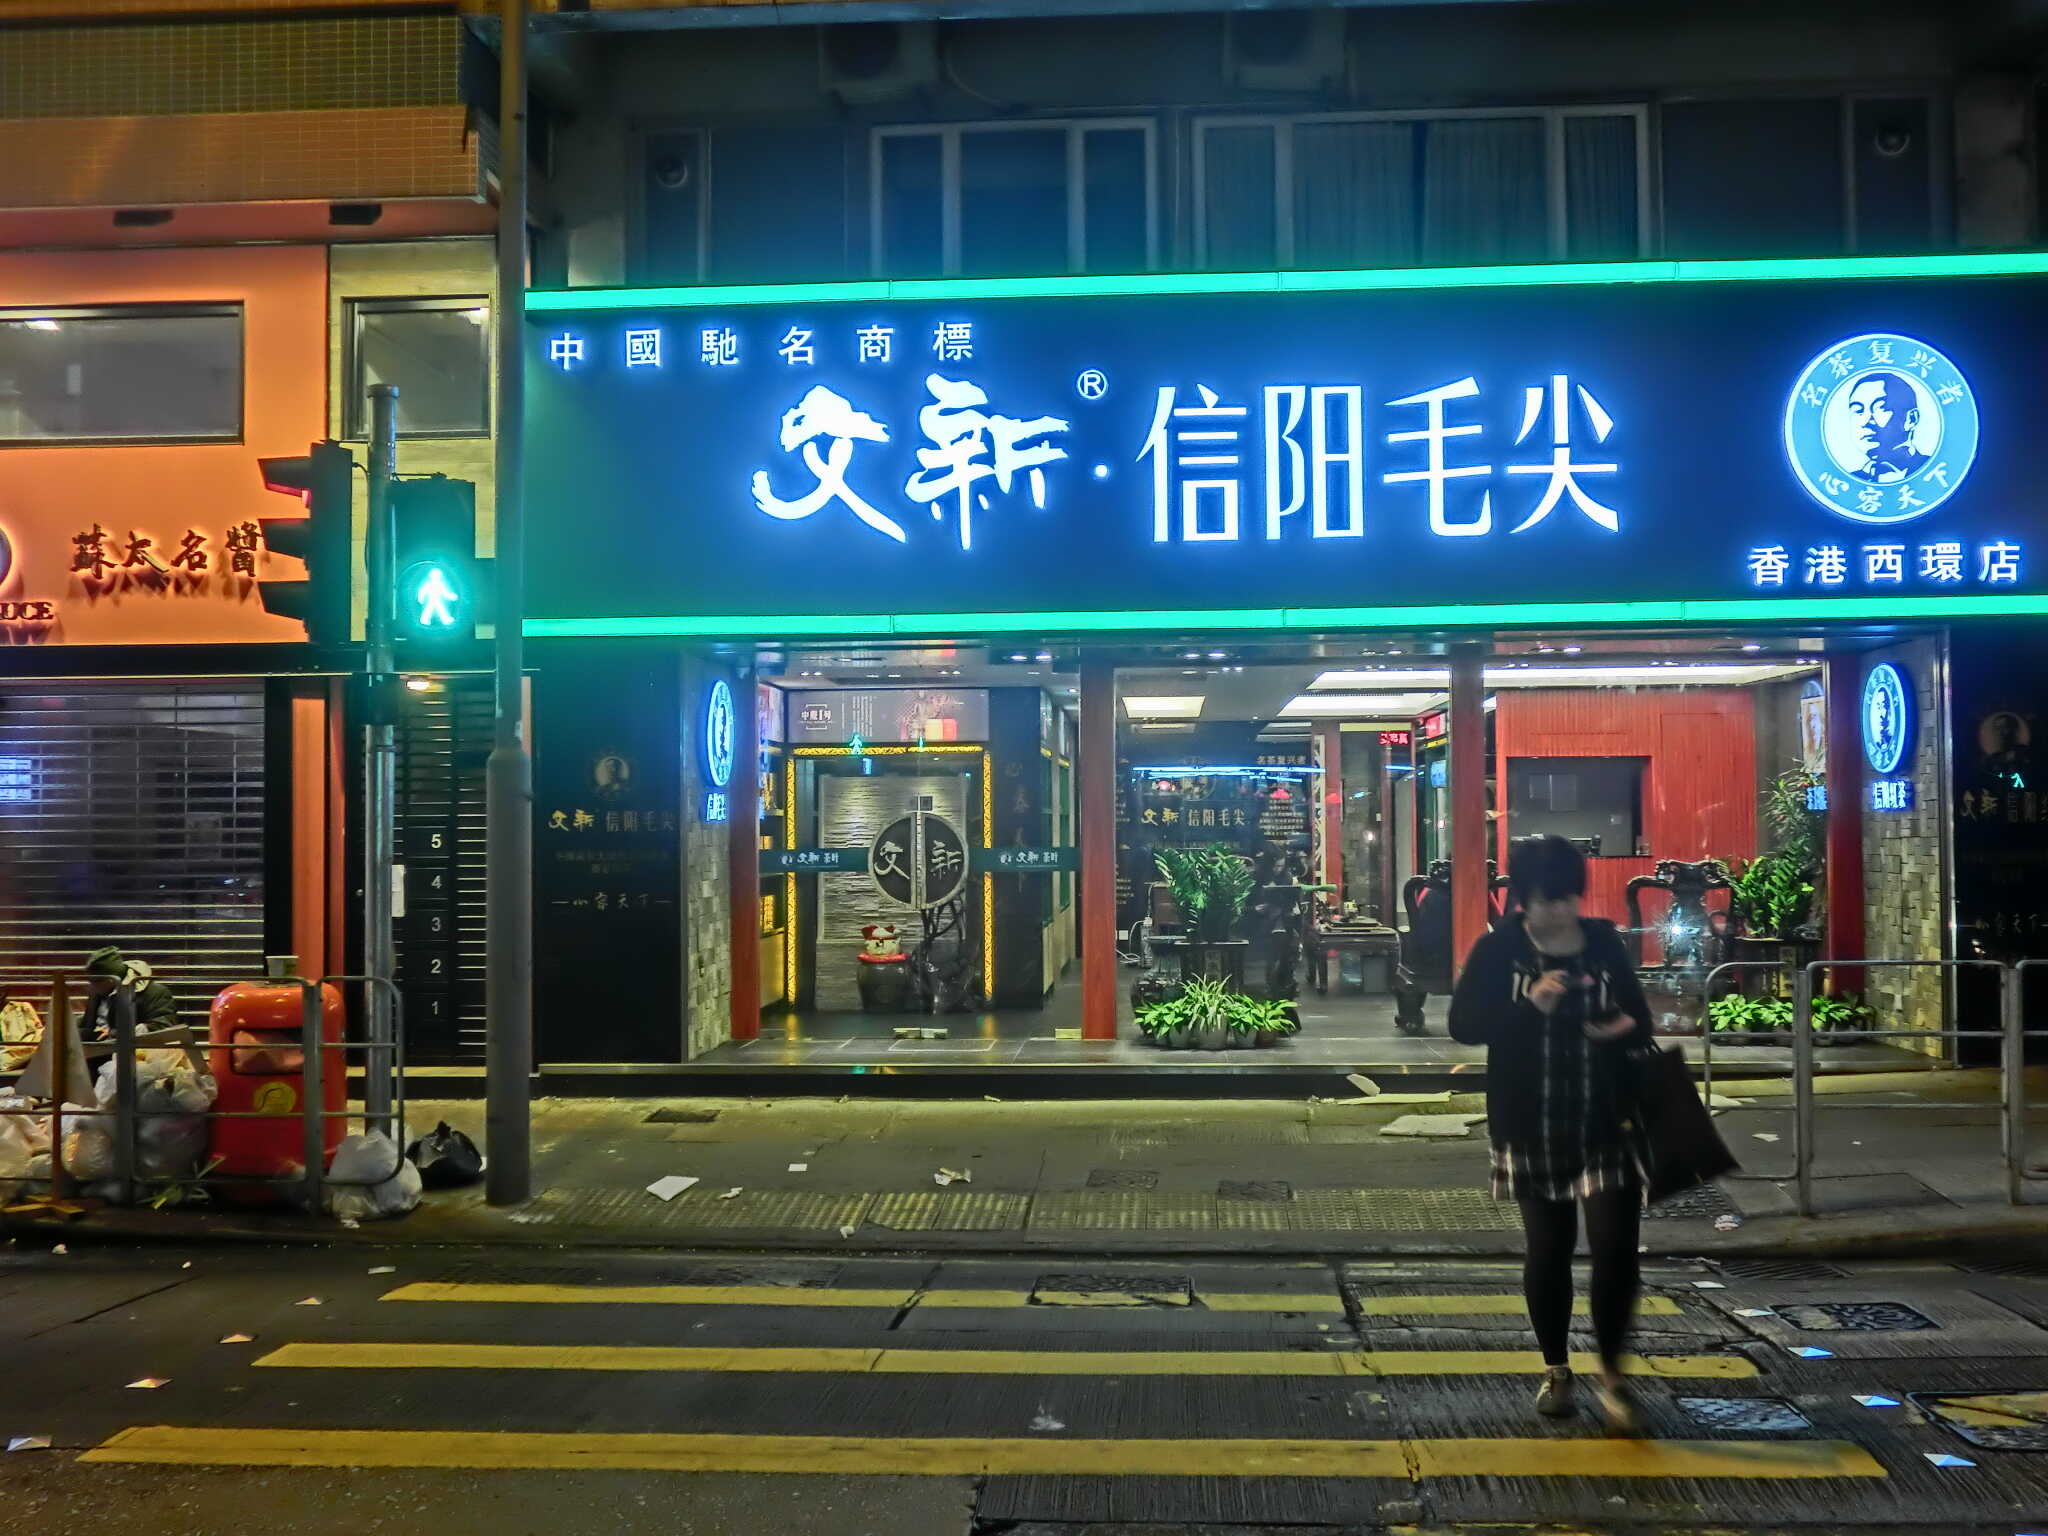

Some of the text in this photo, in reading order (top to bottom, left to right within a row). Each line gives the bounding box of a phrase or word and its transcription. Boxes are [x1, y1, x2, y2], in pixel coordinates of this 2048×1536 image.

[550, 321, 972, 370] 中國馳名商標
[1800, 340, 1964, 408] 名茶复兴者
[1135, 374, 1619, 542] 信阳毛尖
[70, 521, 262, 579] 蘇太名醬
[1749, 542, 2021, 584] 香港西環店
[1188, 808, 1245, 827] 信阳毛尖
[431, 834, 442, 849] 5
[431, 875, 442, 889] 4
[431, 917, 441, 932] 3
[431, 959, 441, 974] 2
[431, 1001, 439, 1015] 1
